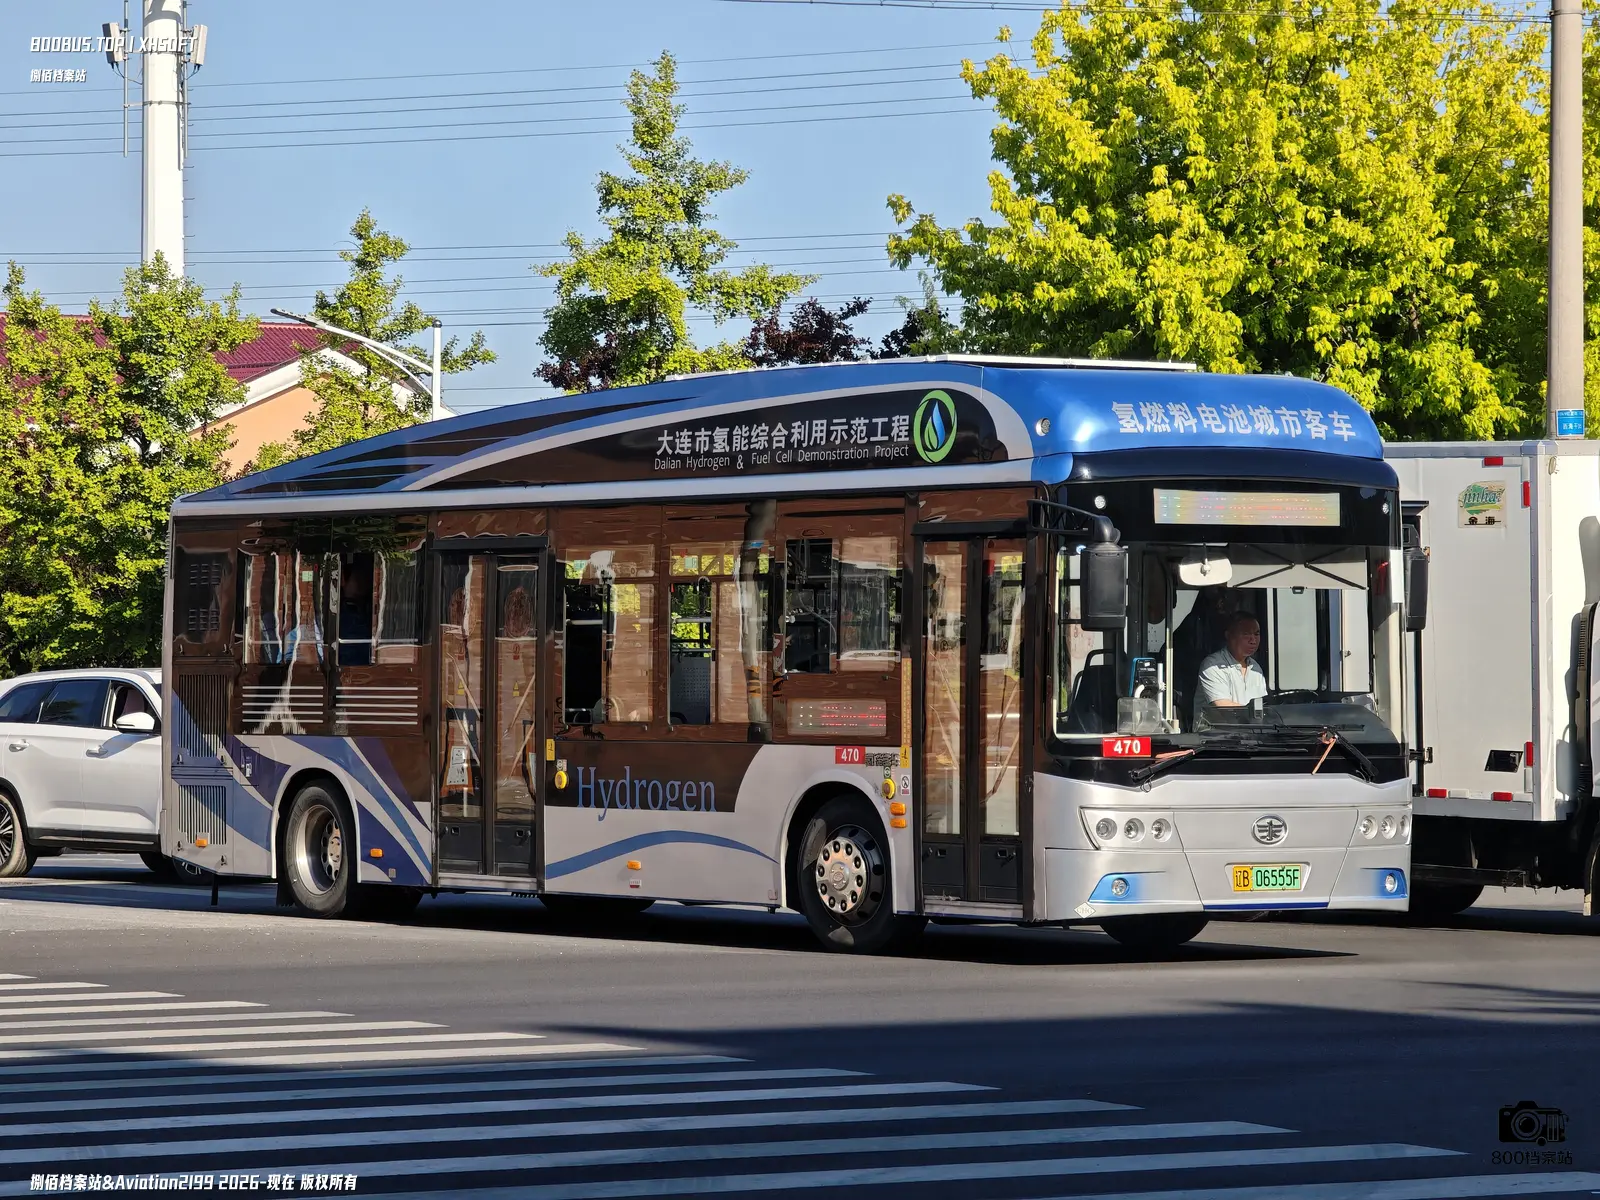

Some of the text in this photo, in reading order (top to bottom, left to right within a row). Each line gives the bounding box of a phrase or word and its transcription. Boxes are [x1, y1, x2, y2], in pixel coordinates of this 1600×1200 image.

[656, 413, 910, 456] 大连市氢能综合利用示范工程
[1111, 400, 1357, 442] 氢燃料电池城市客车
[654, 443, 910, 472] Dalian Hydrogen & Fuel Cell Demonstration Project
[841, 748, 859, 762] 470
[1114, 739, 1141, 755] 470
[577, 765, 717, 821] Hydrogen
